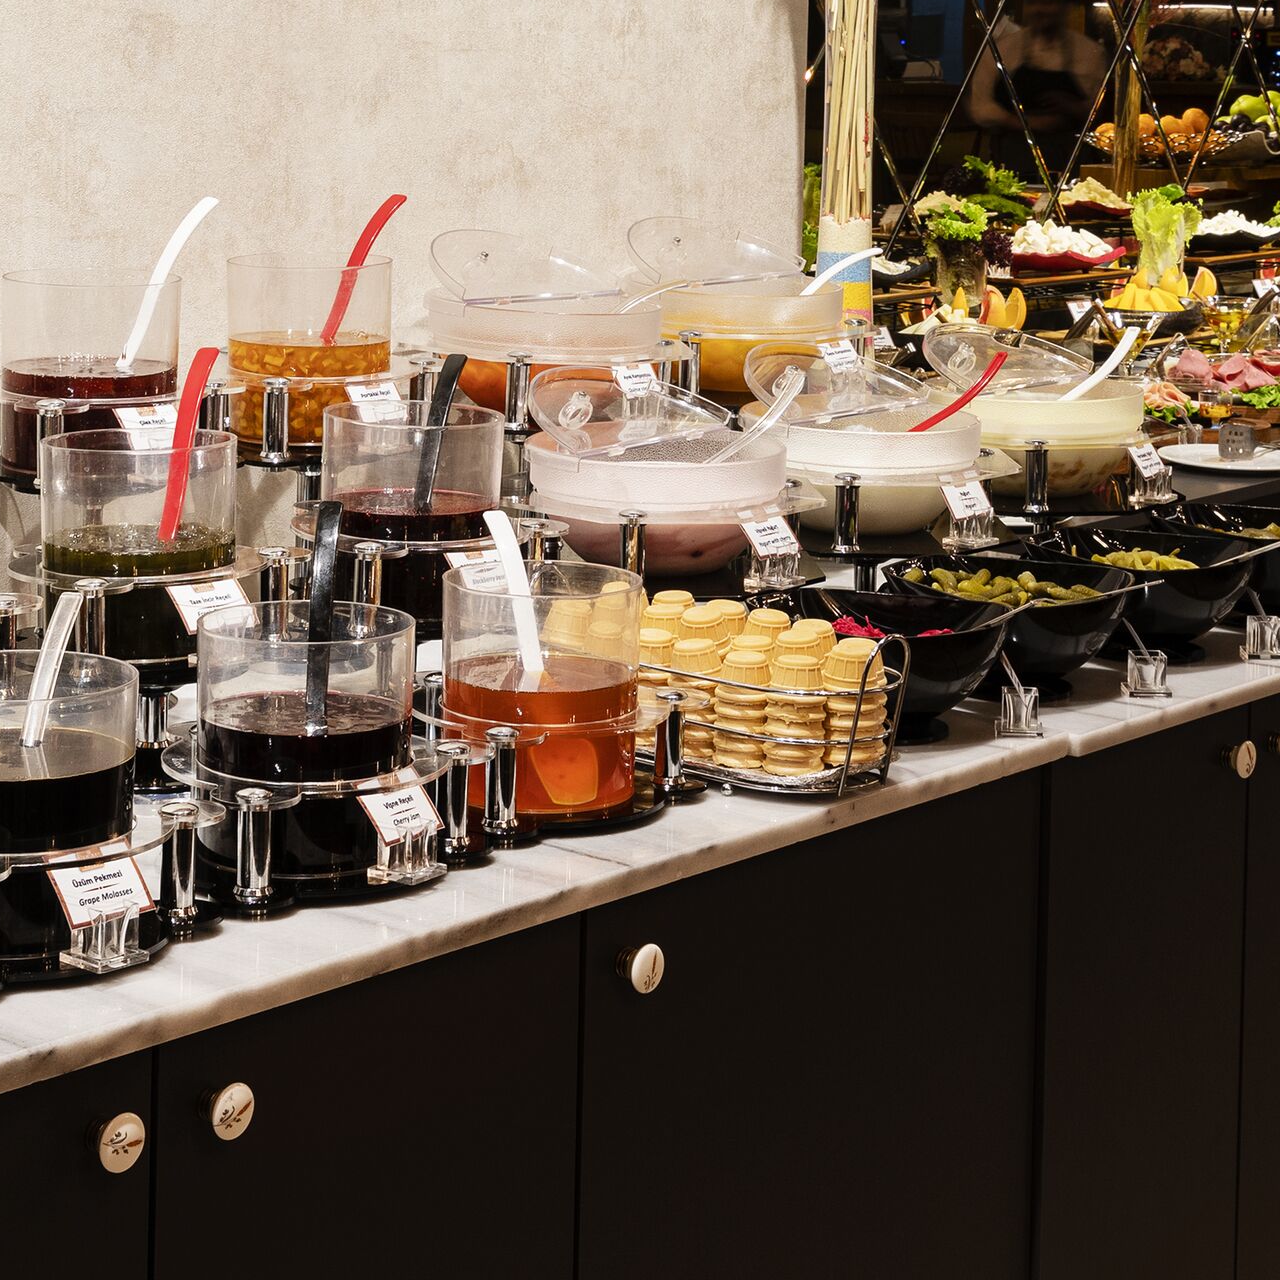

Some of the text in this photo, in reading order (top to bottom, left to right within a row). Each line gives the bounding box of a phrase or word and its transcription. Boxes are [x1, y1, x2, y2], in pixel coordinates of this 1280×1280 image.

[72, 869, 123, 888] Üzüm Pekmezi
[78, 887, 134, 907] Grape Molasses
